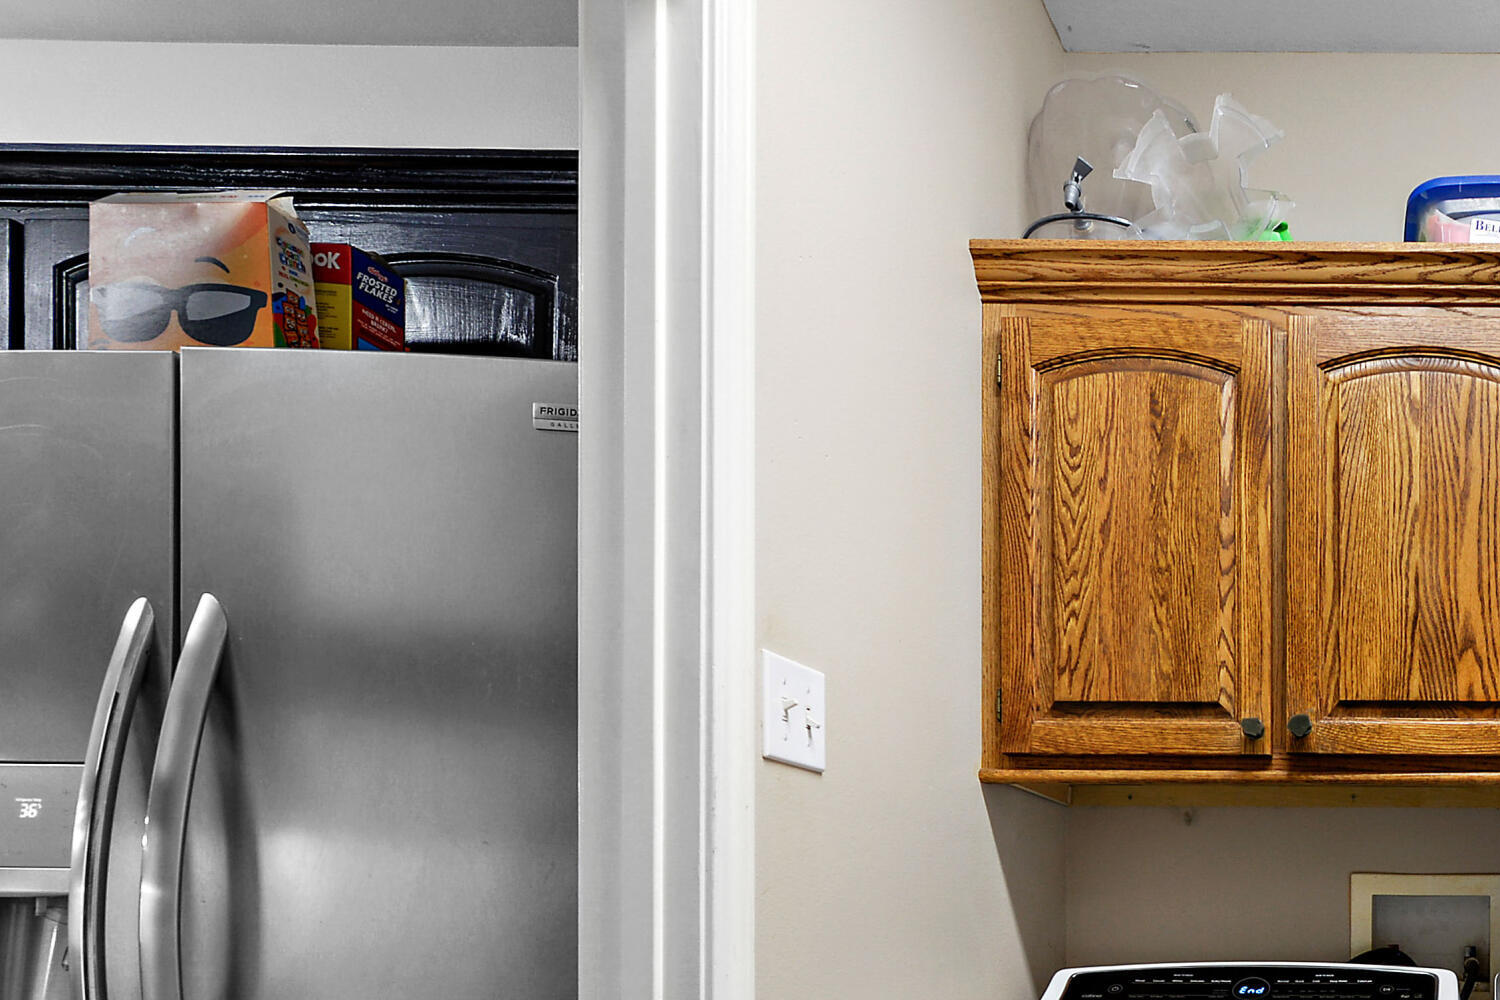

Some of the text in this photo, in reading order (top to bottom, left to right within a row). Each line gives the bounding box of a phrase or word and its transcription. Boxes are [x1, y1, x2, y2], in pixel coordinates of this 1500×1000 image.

[356, 272, 398, 297] FROSTED
[359, 282, 394, 304] FLAKES
[1238, 985, 1265, 995] End
